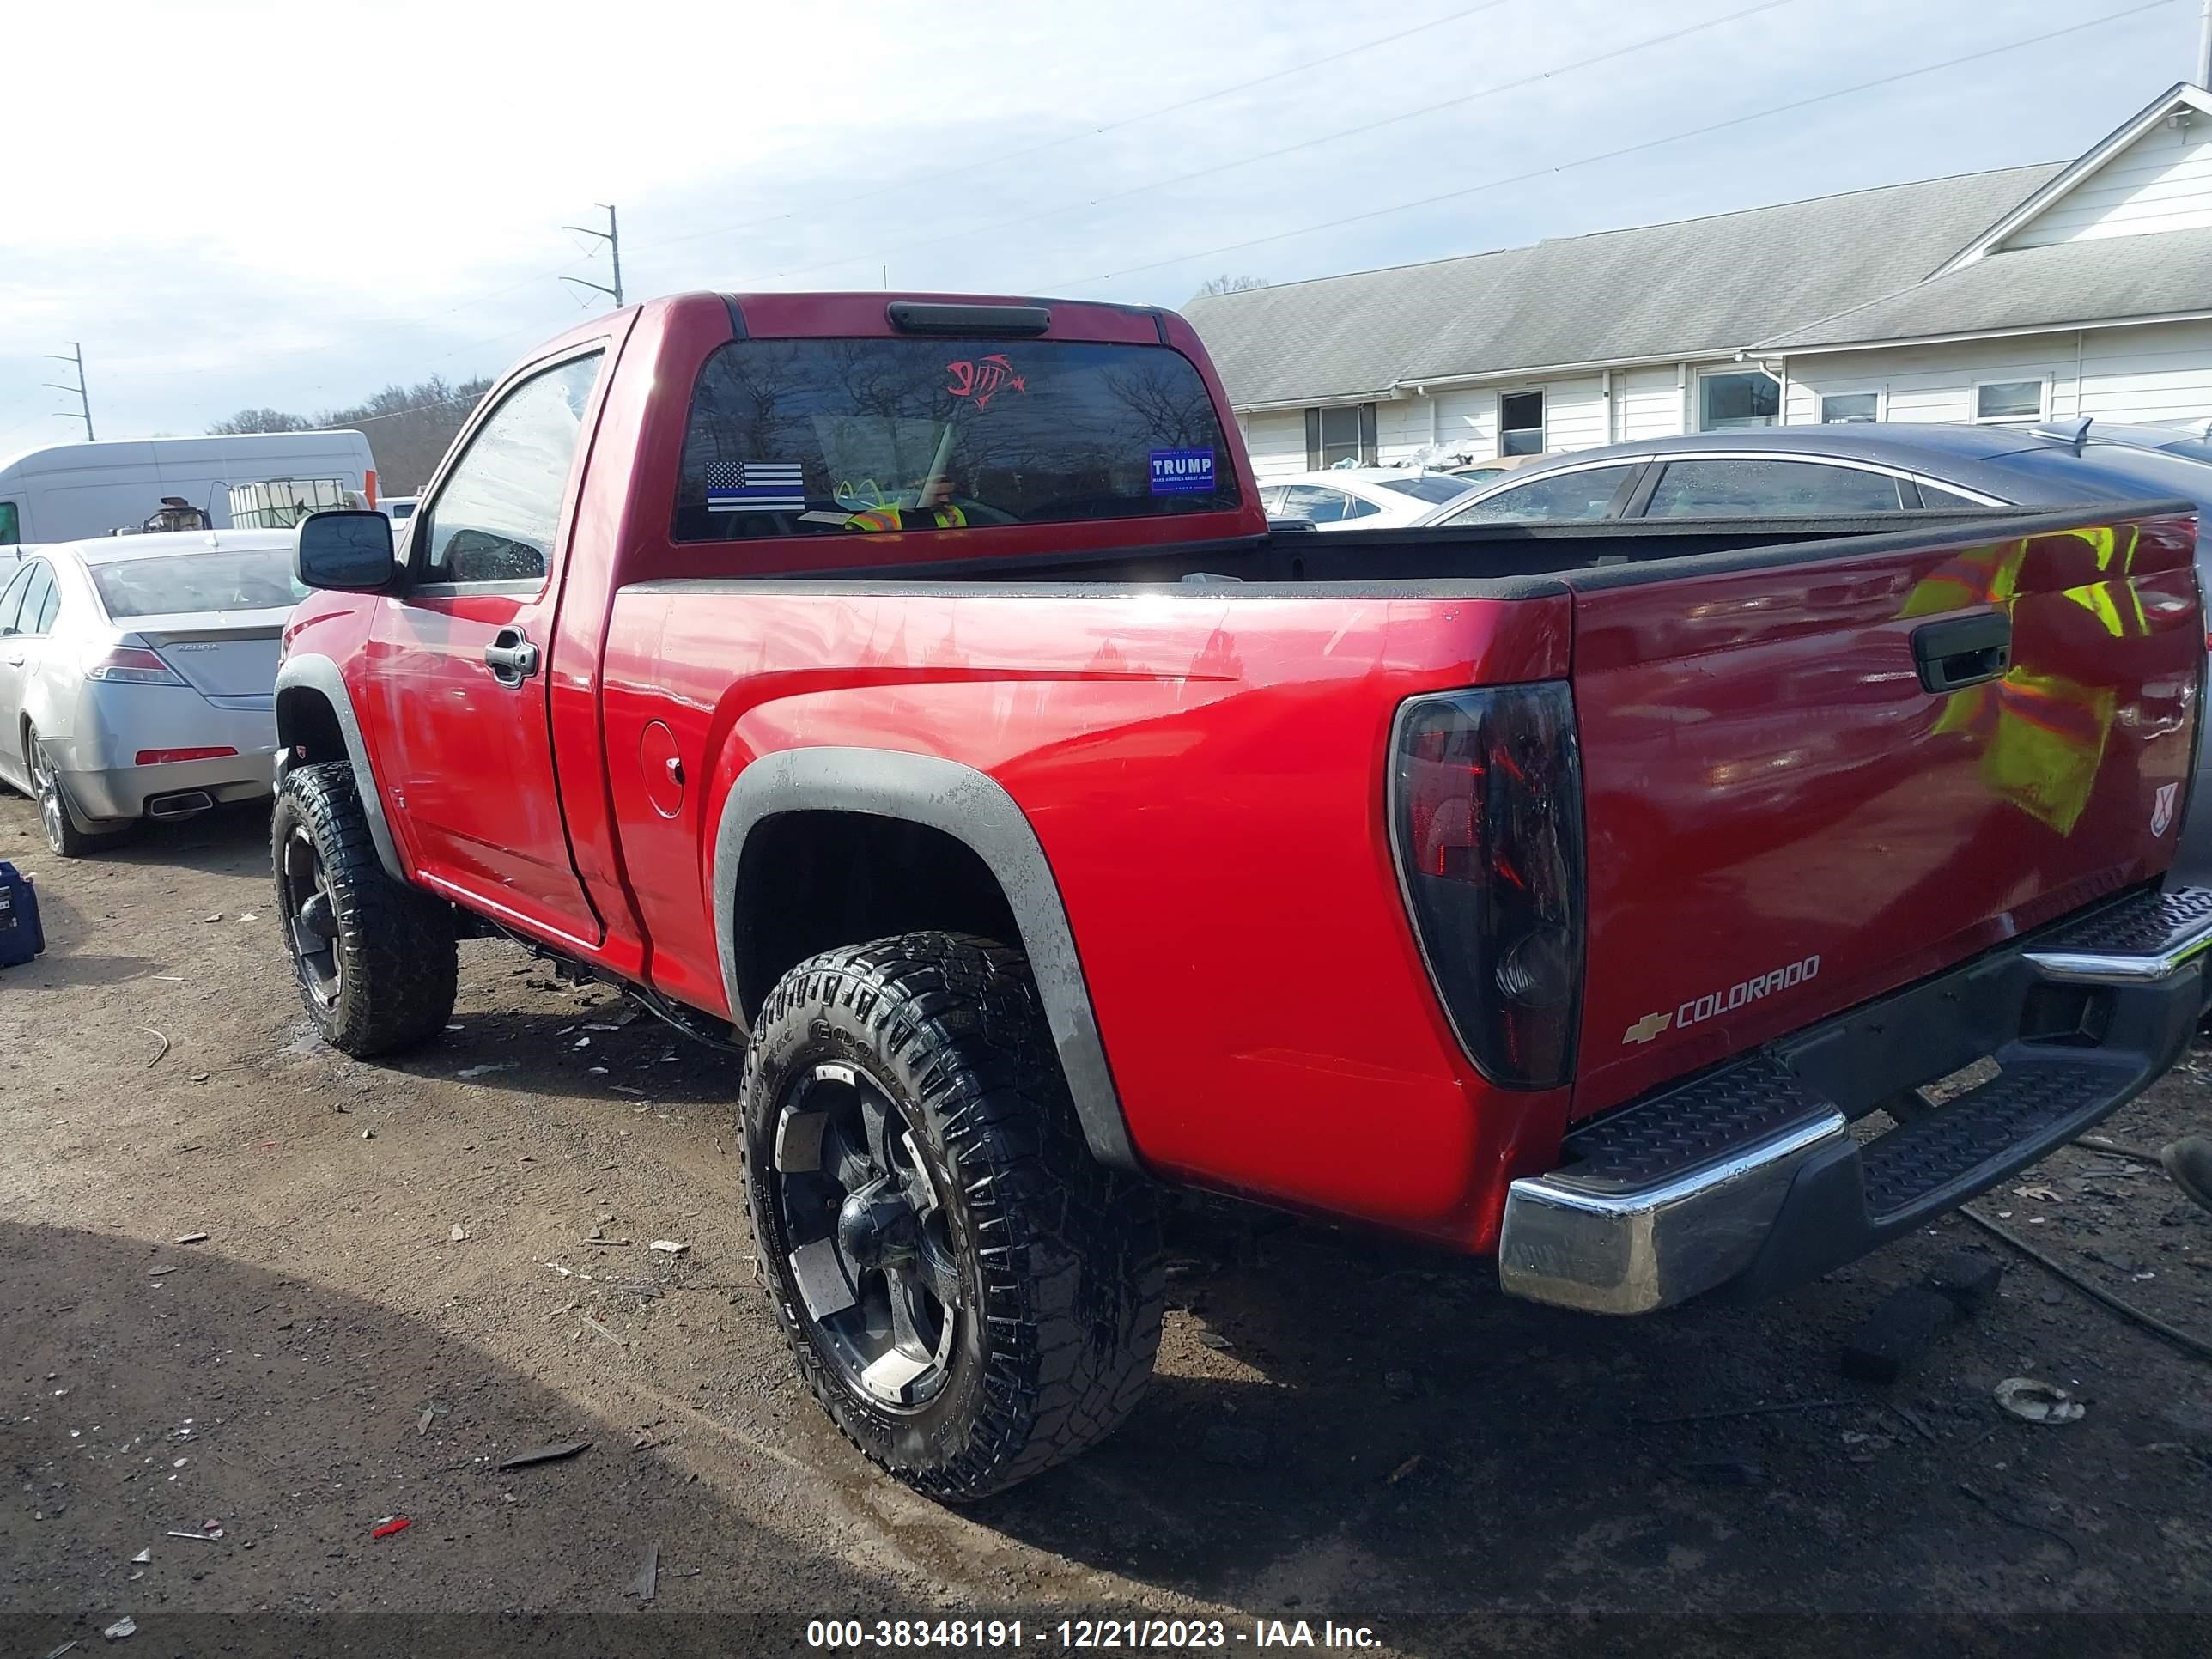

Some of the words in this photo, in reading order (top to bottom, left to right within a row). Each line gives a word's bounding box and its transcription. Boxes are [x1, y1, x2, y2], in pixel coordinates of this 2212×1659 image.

[1152, 458, 1212, 476] TRUMP
[178, 644, 220, 653] ACURA
[1676, 954, 1820, 1029] COLORADO
